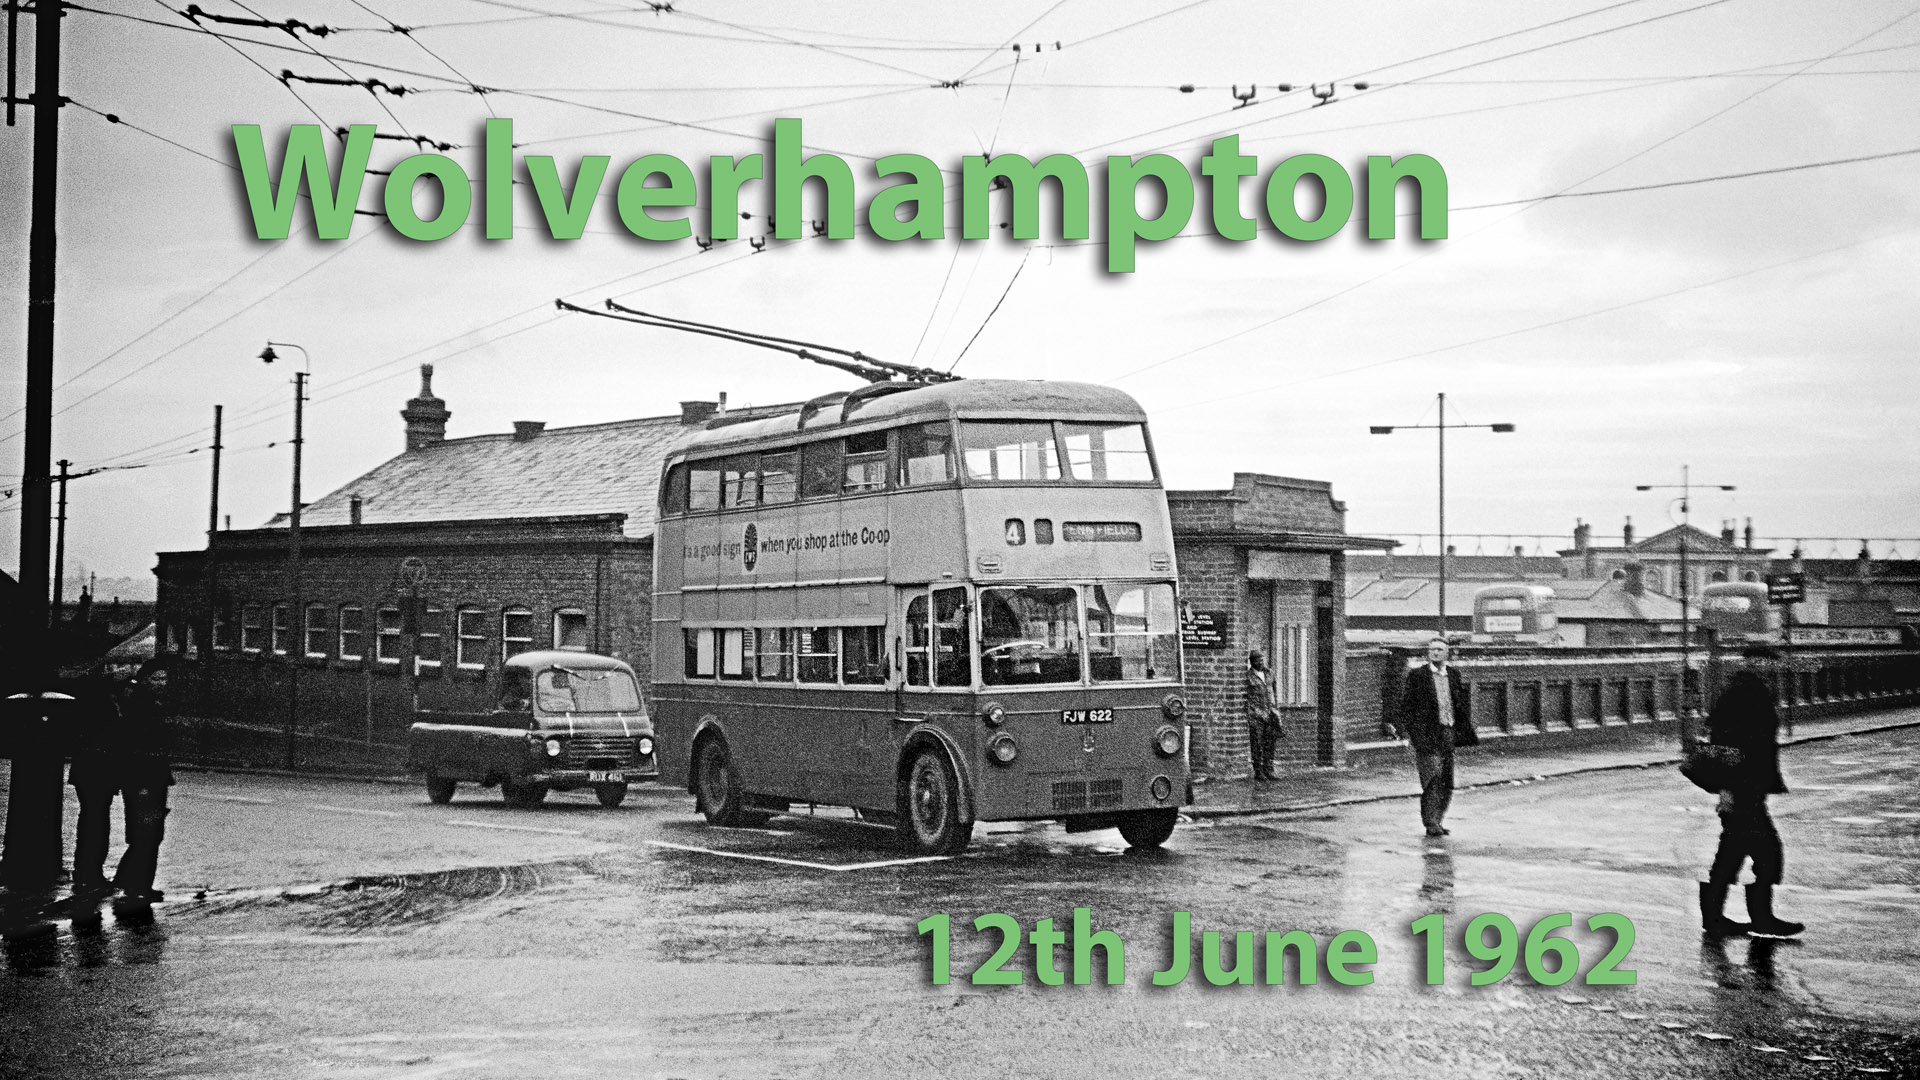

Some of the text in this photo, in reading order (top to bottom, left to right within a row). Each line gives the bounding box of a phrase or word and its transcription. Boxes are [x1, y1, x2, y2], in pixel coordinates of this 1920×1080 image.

[700, 541, 721, 561] good
[723, 542, 741, 560] sign
[761, 537, 784, 552] when
[786, 537, 802, 555] you
[804, 533, 828, 552] shop
[829, 532, 840, 547] at
[841, 530, 858, 547] the
[860, 527, 891, 546] Co-op
[1006, 522, 1021, 544] 4
[1063, 709, 1112, 722] FJW 622
